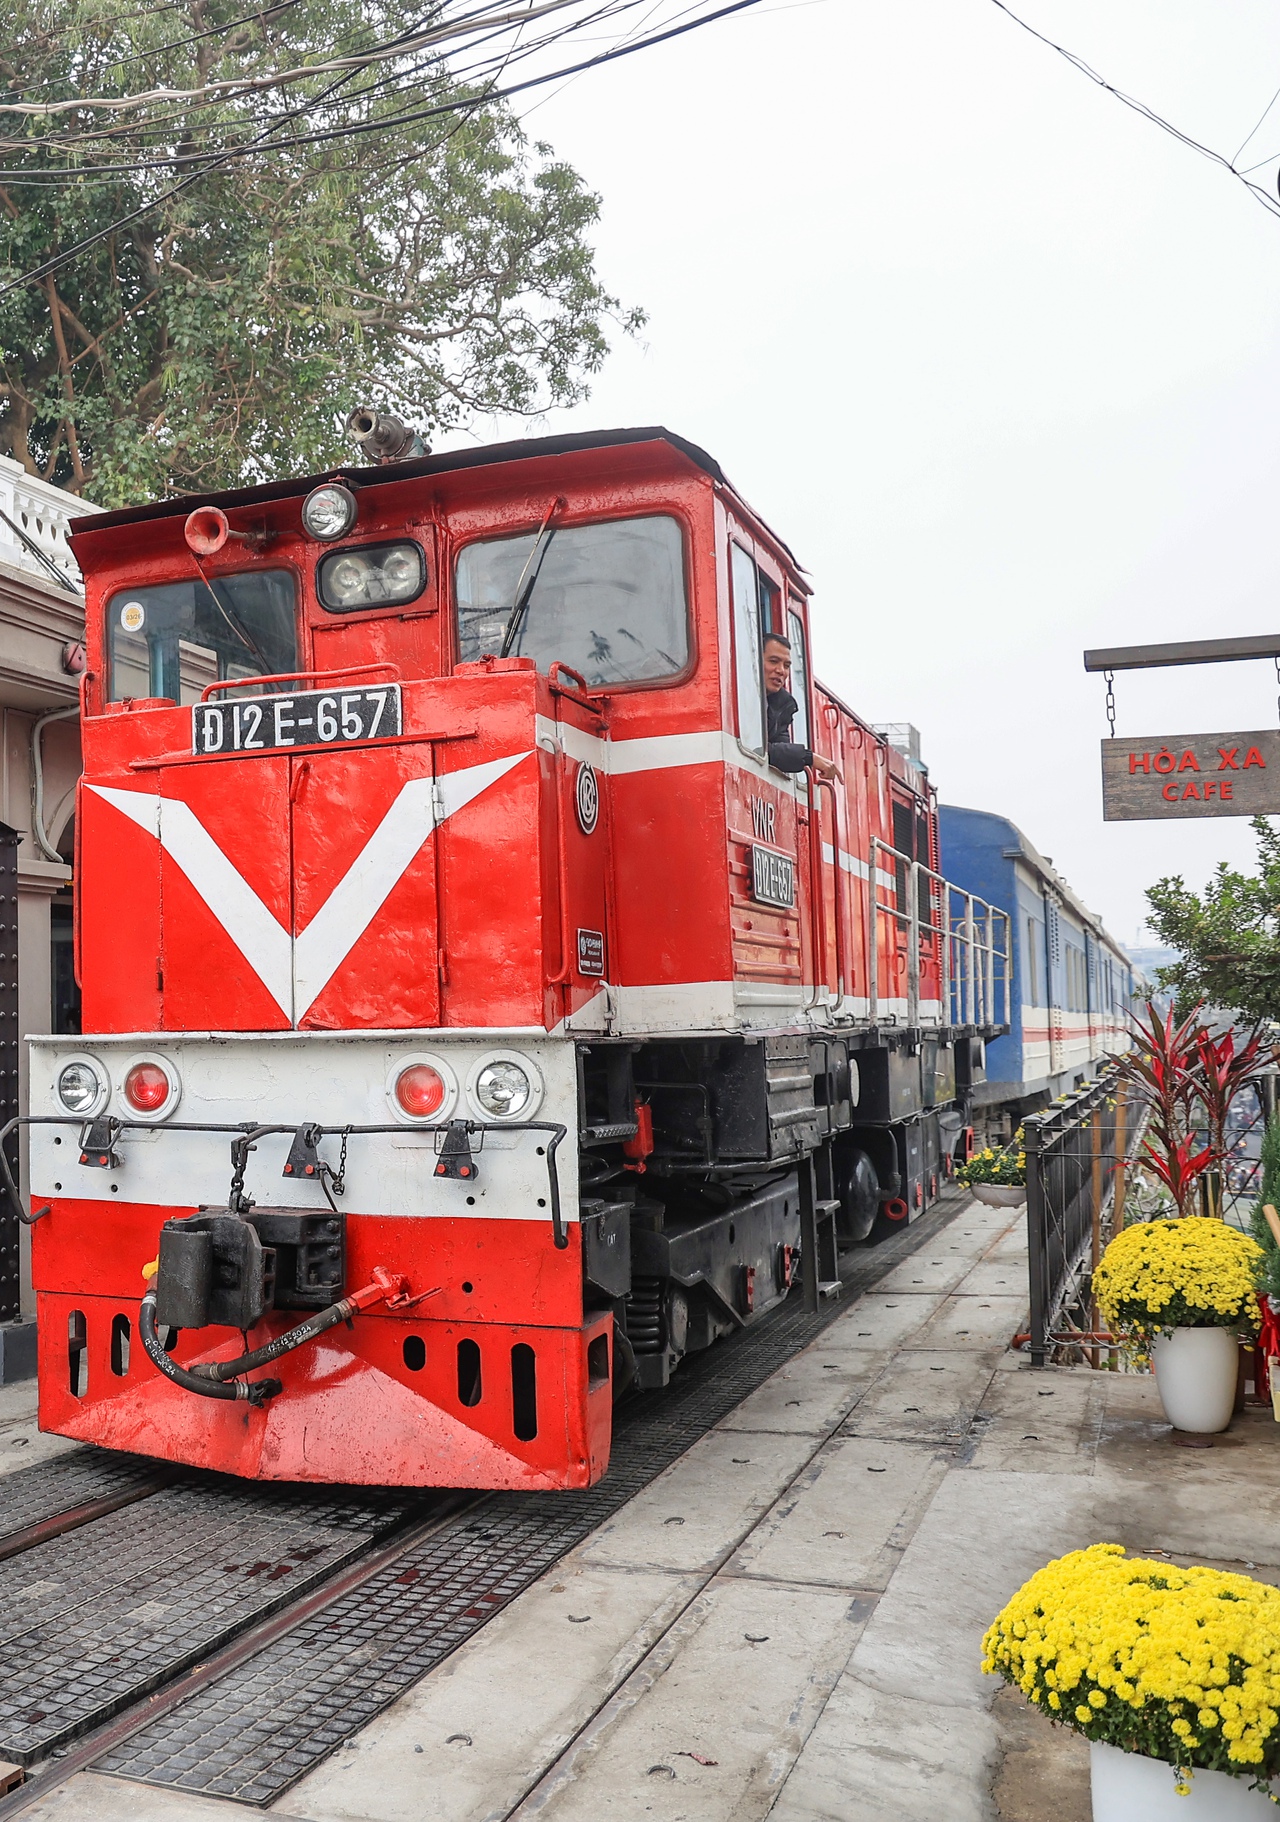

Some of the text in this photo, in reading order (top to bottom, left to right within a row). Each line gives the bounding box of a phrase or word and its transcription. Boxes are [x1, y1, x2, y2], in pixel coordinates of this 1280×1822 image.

[1217, 746, 1266, 771] XA
[1162, 781, 1234, 801] CAFE
[751, 794, 776, 844] VNR
